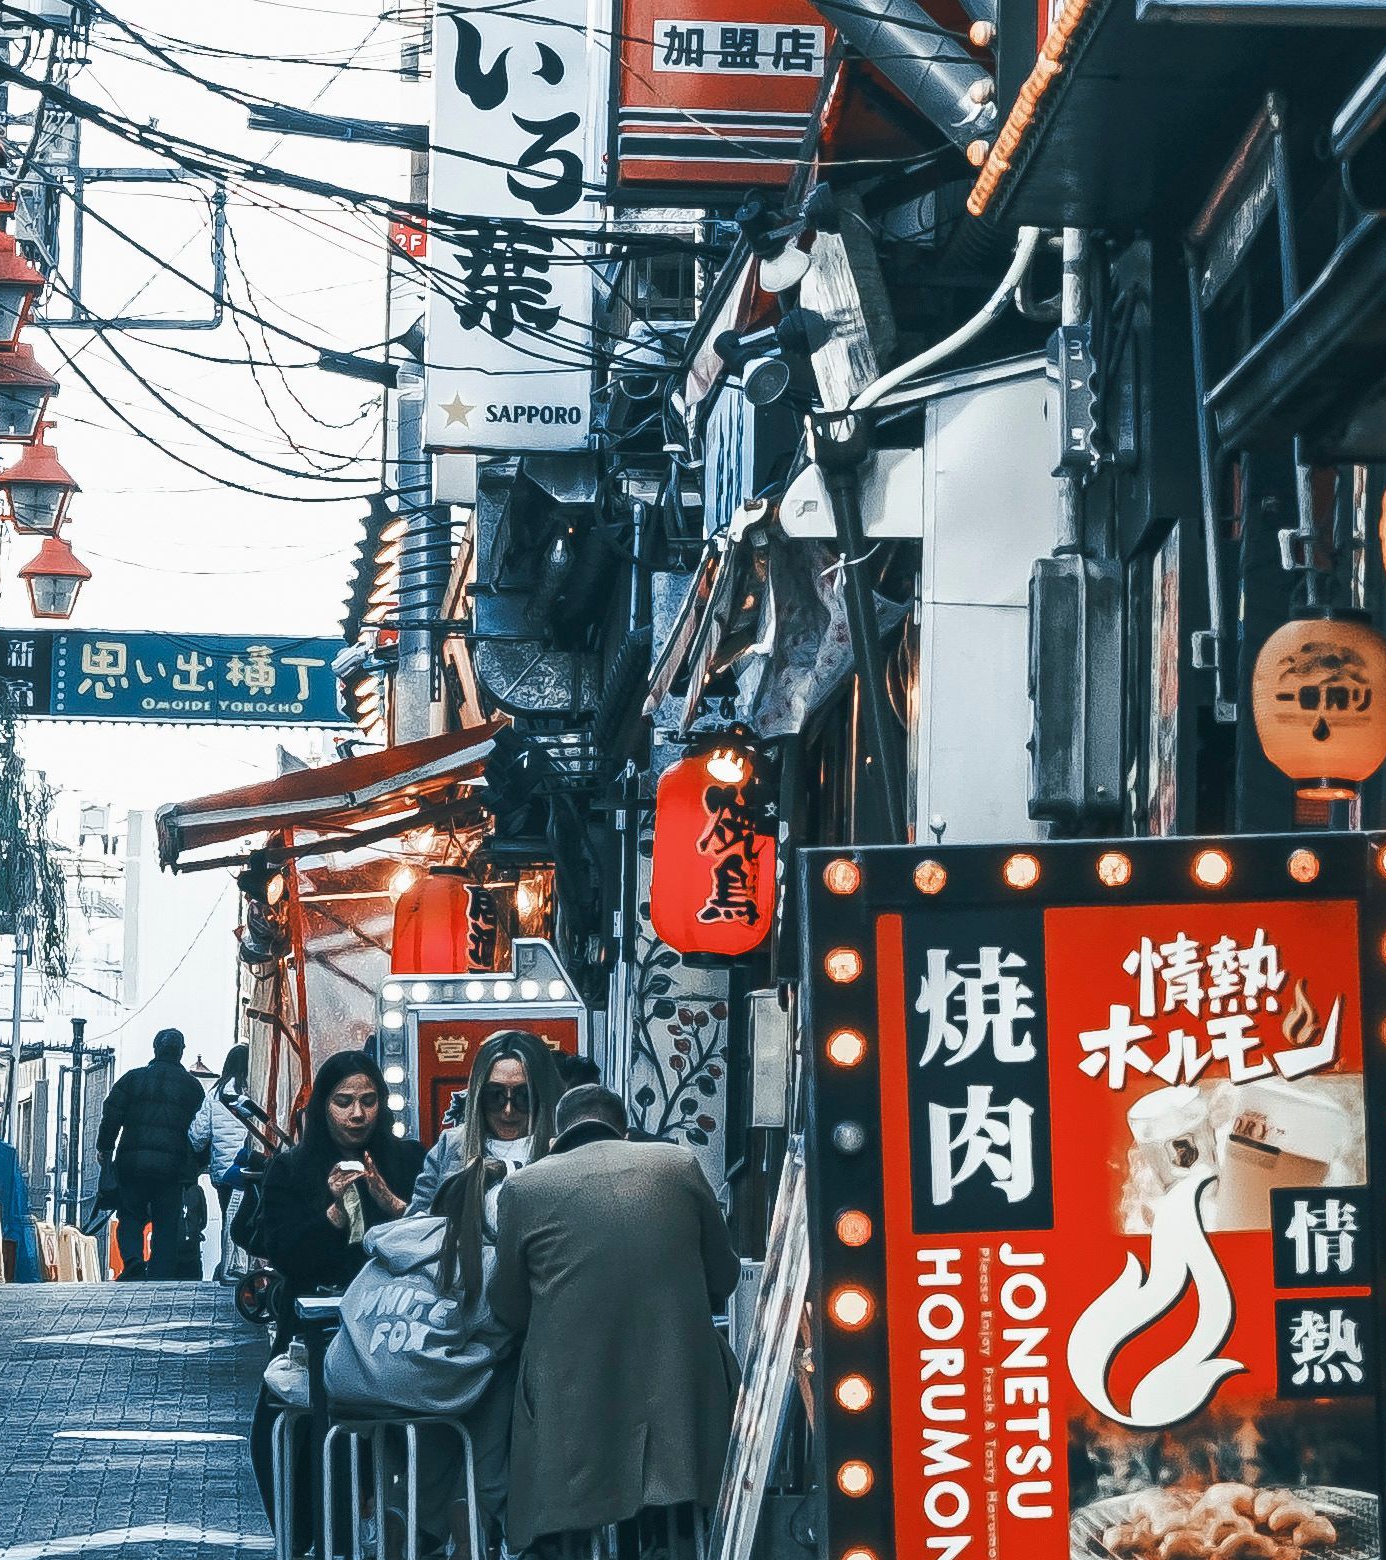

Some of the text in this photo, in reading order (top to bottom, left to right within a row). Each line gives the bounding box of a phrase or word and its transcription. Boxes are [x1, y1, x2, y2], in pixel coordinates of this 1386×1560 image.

[661, 25, 818, 73] 加盟店
[396, 232, 424, 252] 2F
[484, 404, 582, 425] SAPPORO
[77, 641, 327, 700] 思い出横丁
[1121, 927, 1289, 1020] 情熱
[1078, 993, 1345, 1090] ホルモン
[914, 943, 1039, 1208] 焼肉
[977, 1246, 991, 1304] Please
[1284, 1197, 1366, 1390] 情熱
[369, 1320, 431, 1356] FOX
[979, 1310, 993, 1358] Enjoy
[998, 1241, 1053, 1522] JONETSU
[983, 1437, 998, 1485] Tasty
